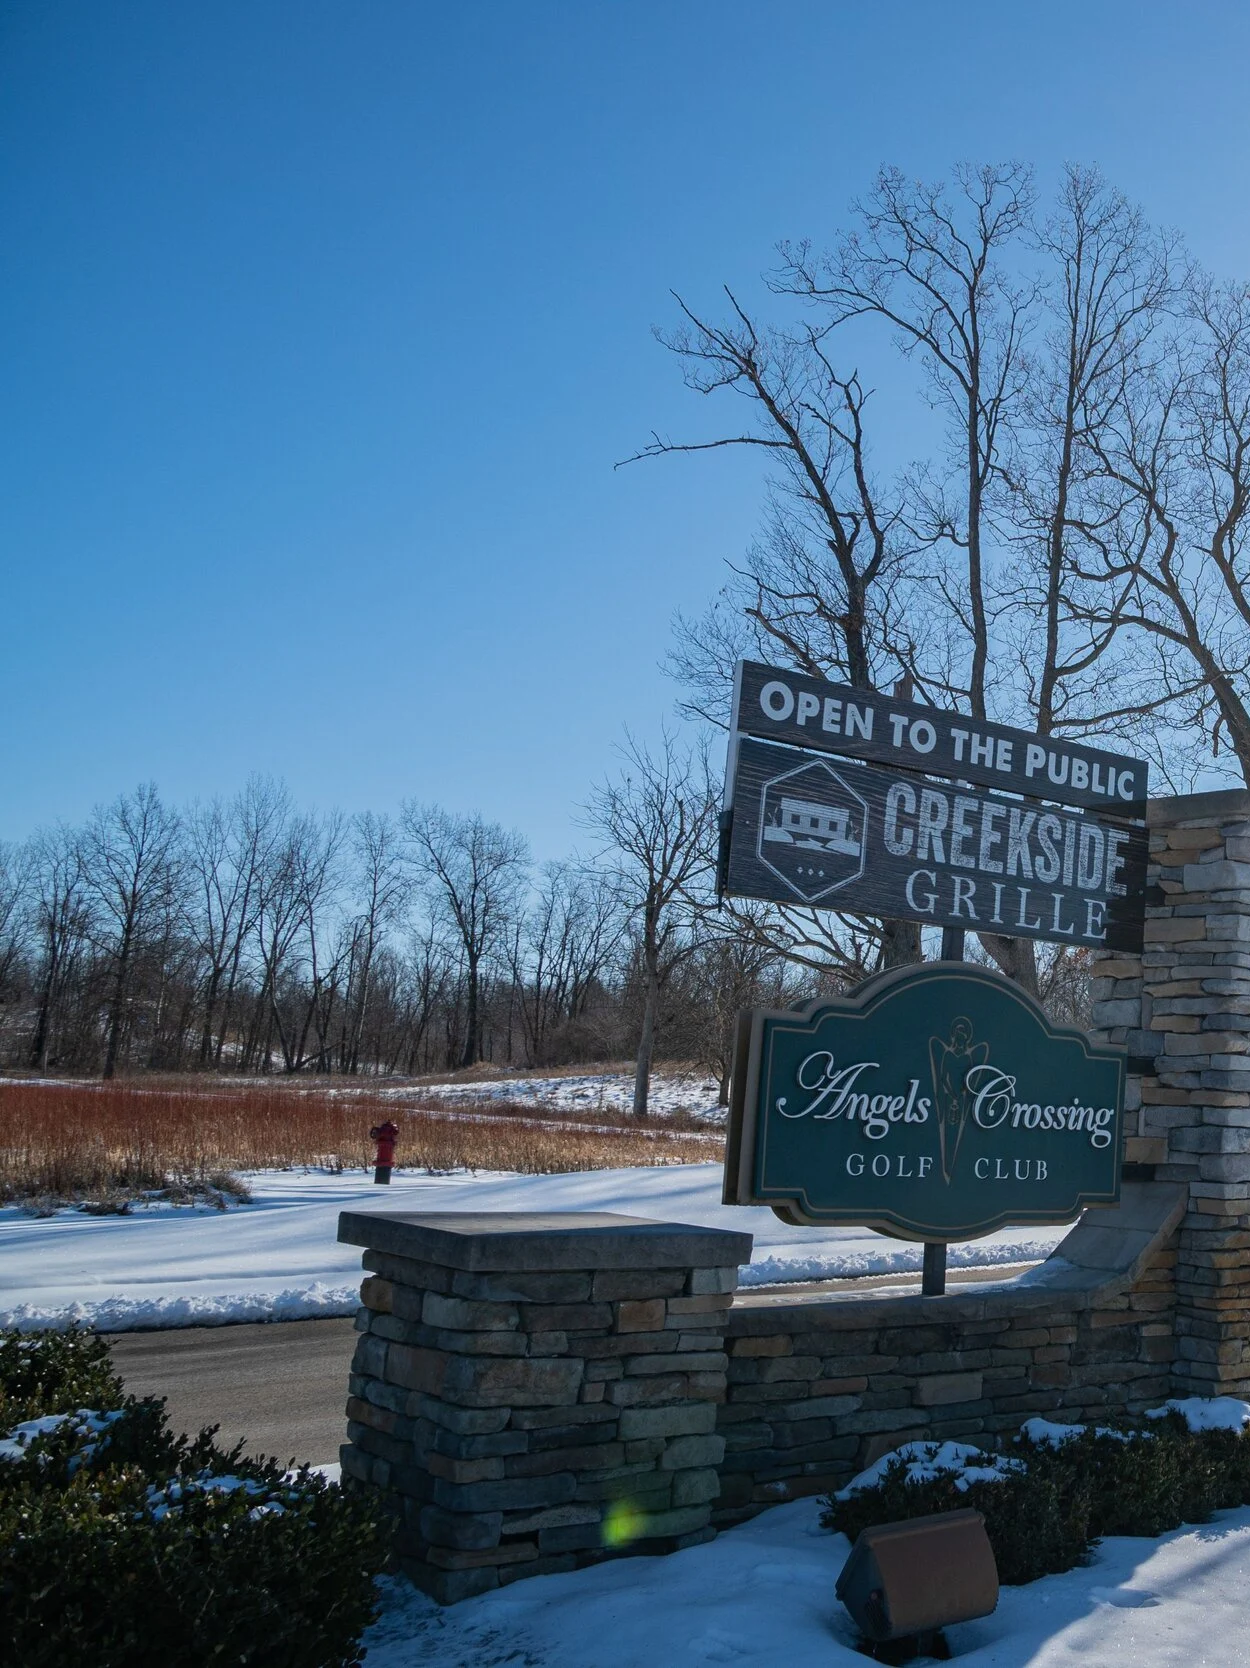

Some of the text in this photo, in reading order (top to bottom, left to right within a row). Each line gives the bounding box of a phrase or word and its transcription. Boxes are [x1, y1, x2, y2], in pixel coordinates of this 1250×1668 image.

[760, 681, 1136, 800] OPEN TO THE PUBLIC
[884, 781, 1131, 897] CREEKSIDE
[905, 869, 1108, 940] GRILLE
[776, 1050, 1115, 1149] Angels Crossing
[846, 1153, 1049, 1181] GOLF CLUB
